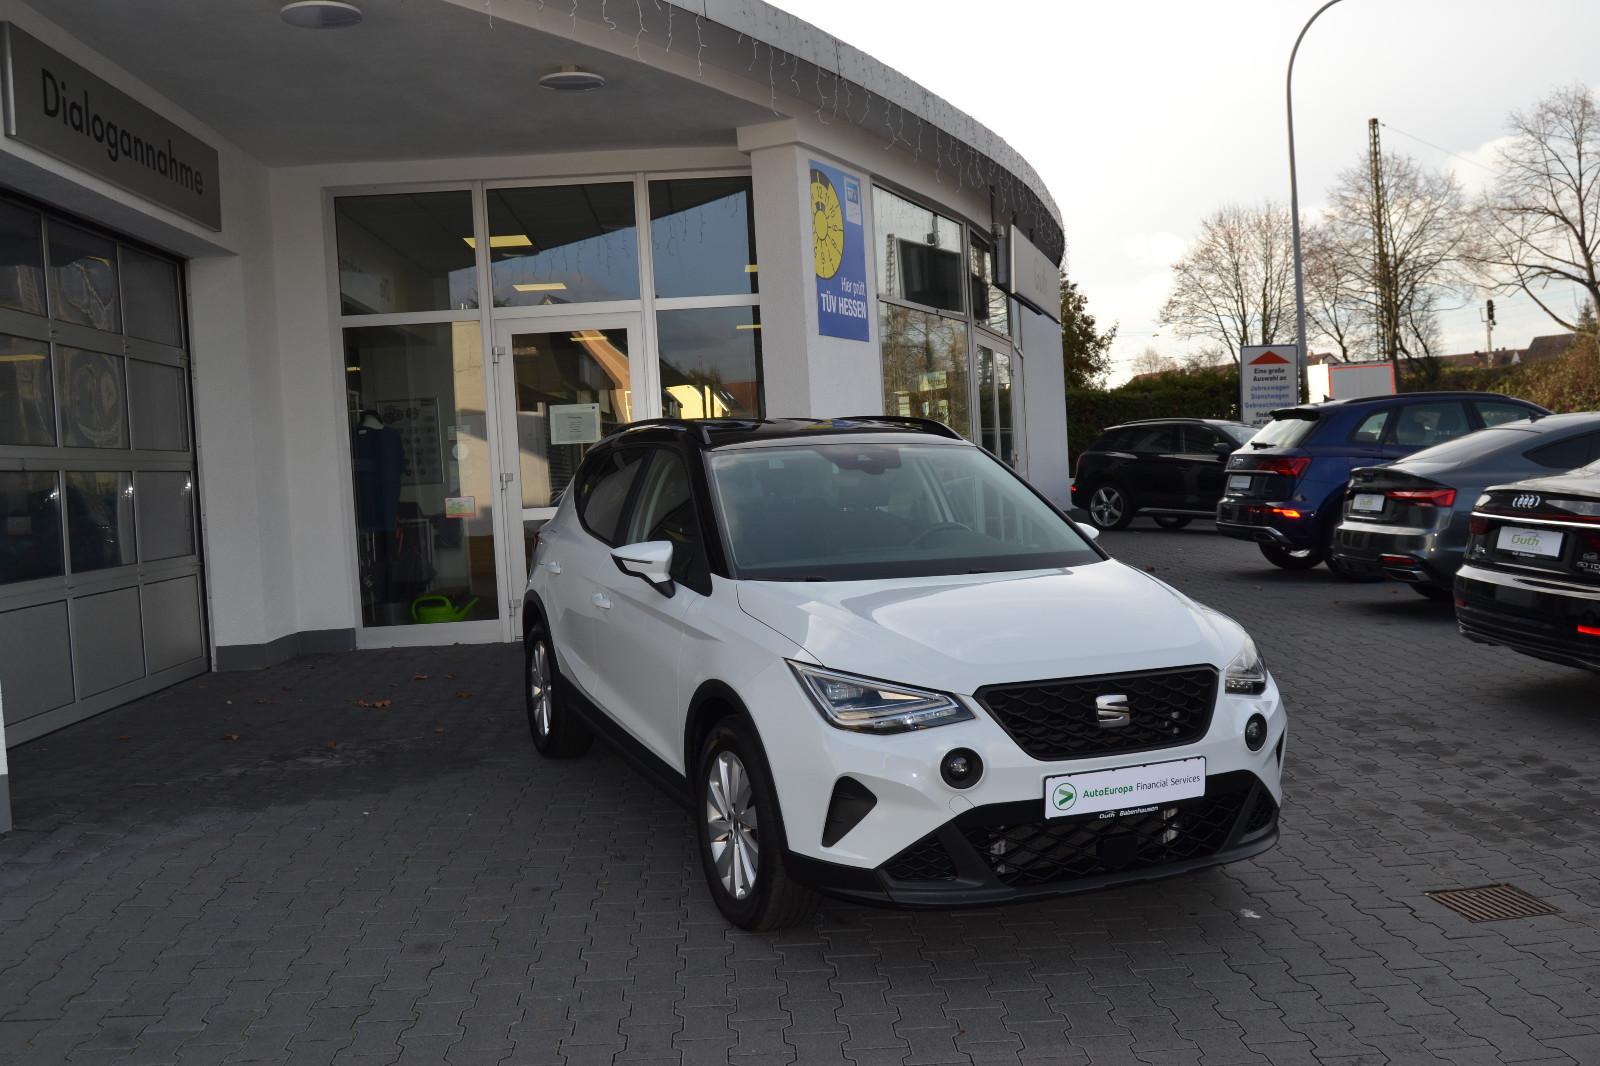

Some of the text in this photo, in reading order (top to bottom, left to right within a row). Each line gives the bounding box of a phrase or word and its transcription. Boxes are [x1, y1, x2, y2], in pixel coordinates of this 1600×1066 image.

[42, 68, 203, 195] Dialogannahme
[841, 277, 852, 292] Hier
[820, 290, 867, 320] TÜV HESSEN
[1268, 367, 1285, 375] große
[1511, 533, 1540, 546] Guth
[1082, 774, 1200, 799] AutoEuropa Financial Services
